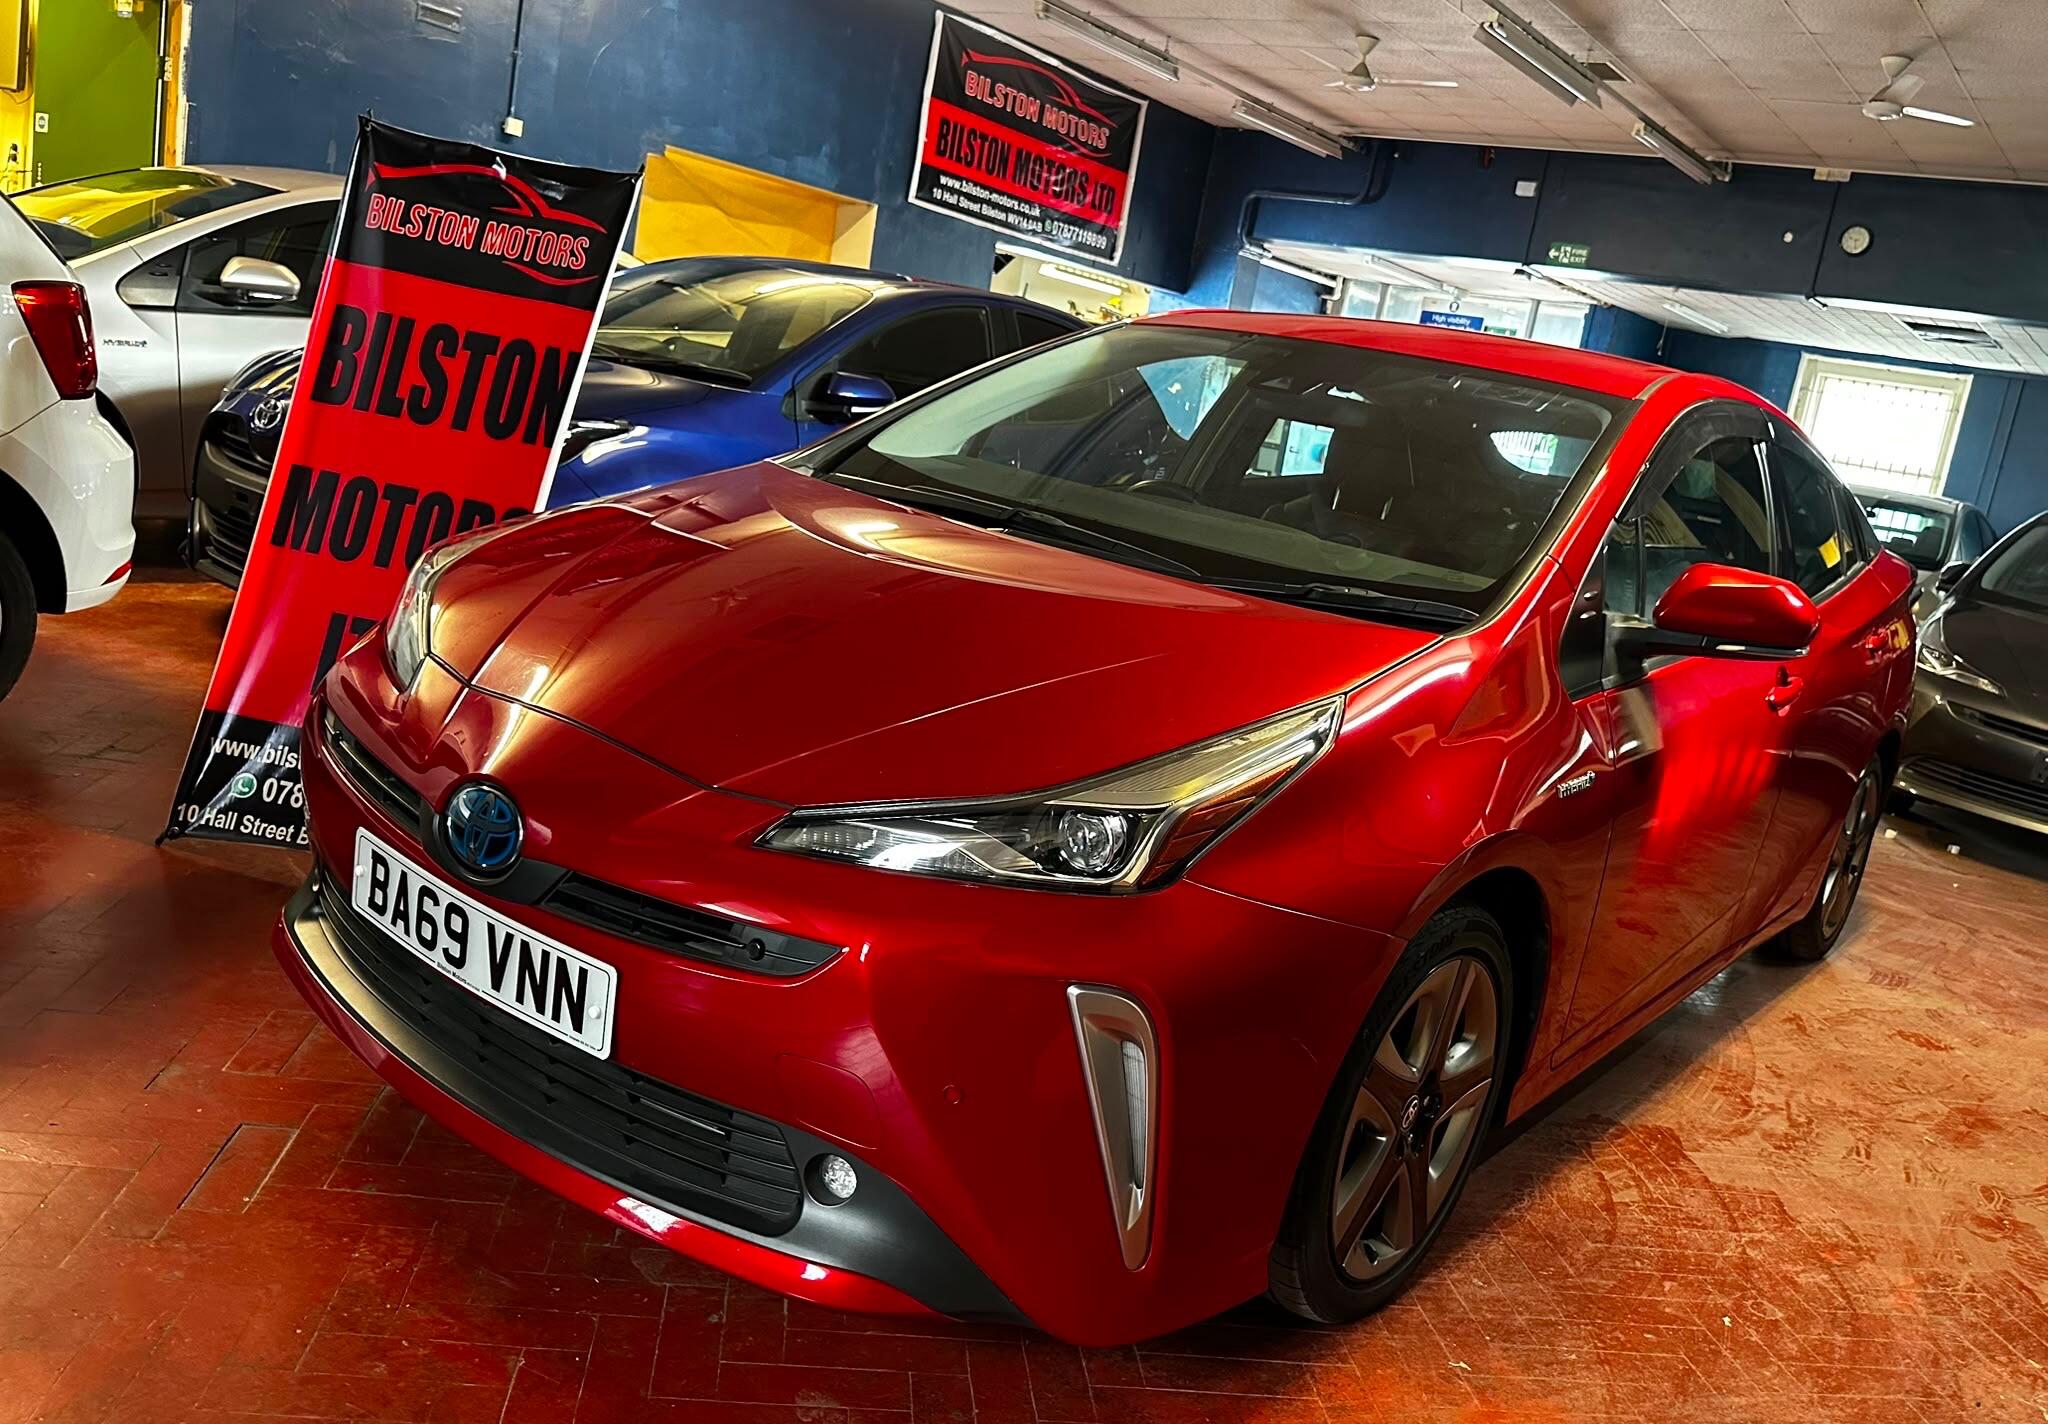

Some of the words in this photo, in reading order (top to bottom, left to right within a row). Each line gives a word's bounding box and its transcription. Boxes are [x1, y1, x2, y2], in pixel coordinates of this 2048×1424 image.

[965, 70, 1040, 123] BILSTON
[1043, 103, 1109, 149] MOTORS
[936, 116, 1011, 180] BILSTON
[1014, 146, 1088, 208] MOTORS
[1091, 181, 1116, 215] LTD
[939, 174, 1041, 217] www.bilston-motors.co.uk
[365, 193, 479, 250] BILSTON
[480, 221, 590, 270] MOTORS
[942, 190, 958, 206] Hall
[959, 196, 981, 212] Street
[981, 203, 1006, 221] Bilston
[1431, 313, 1447, 323] High
[1446, 315, 1471, 326] visibility
[310, 303, 581, 449] BILSTON
[177, 802, 200, 823] 10
[201, 807, 238, 831] Hall
[239, 814, 295, 843] Street
[367, 849, 469, 970] BA69
[487, 921, 589, 1035] VNN
